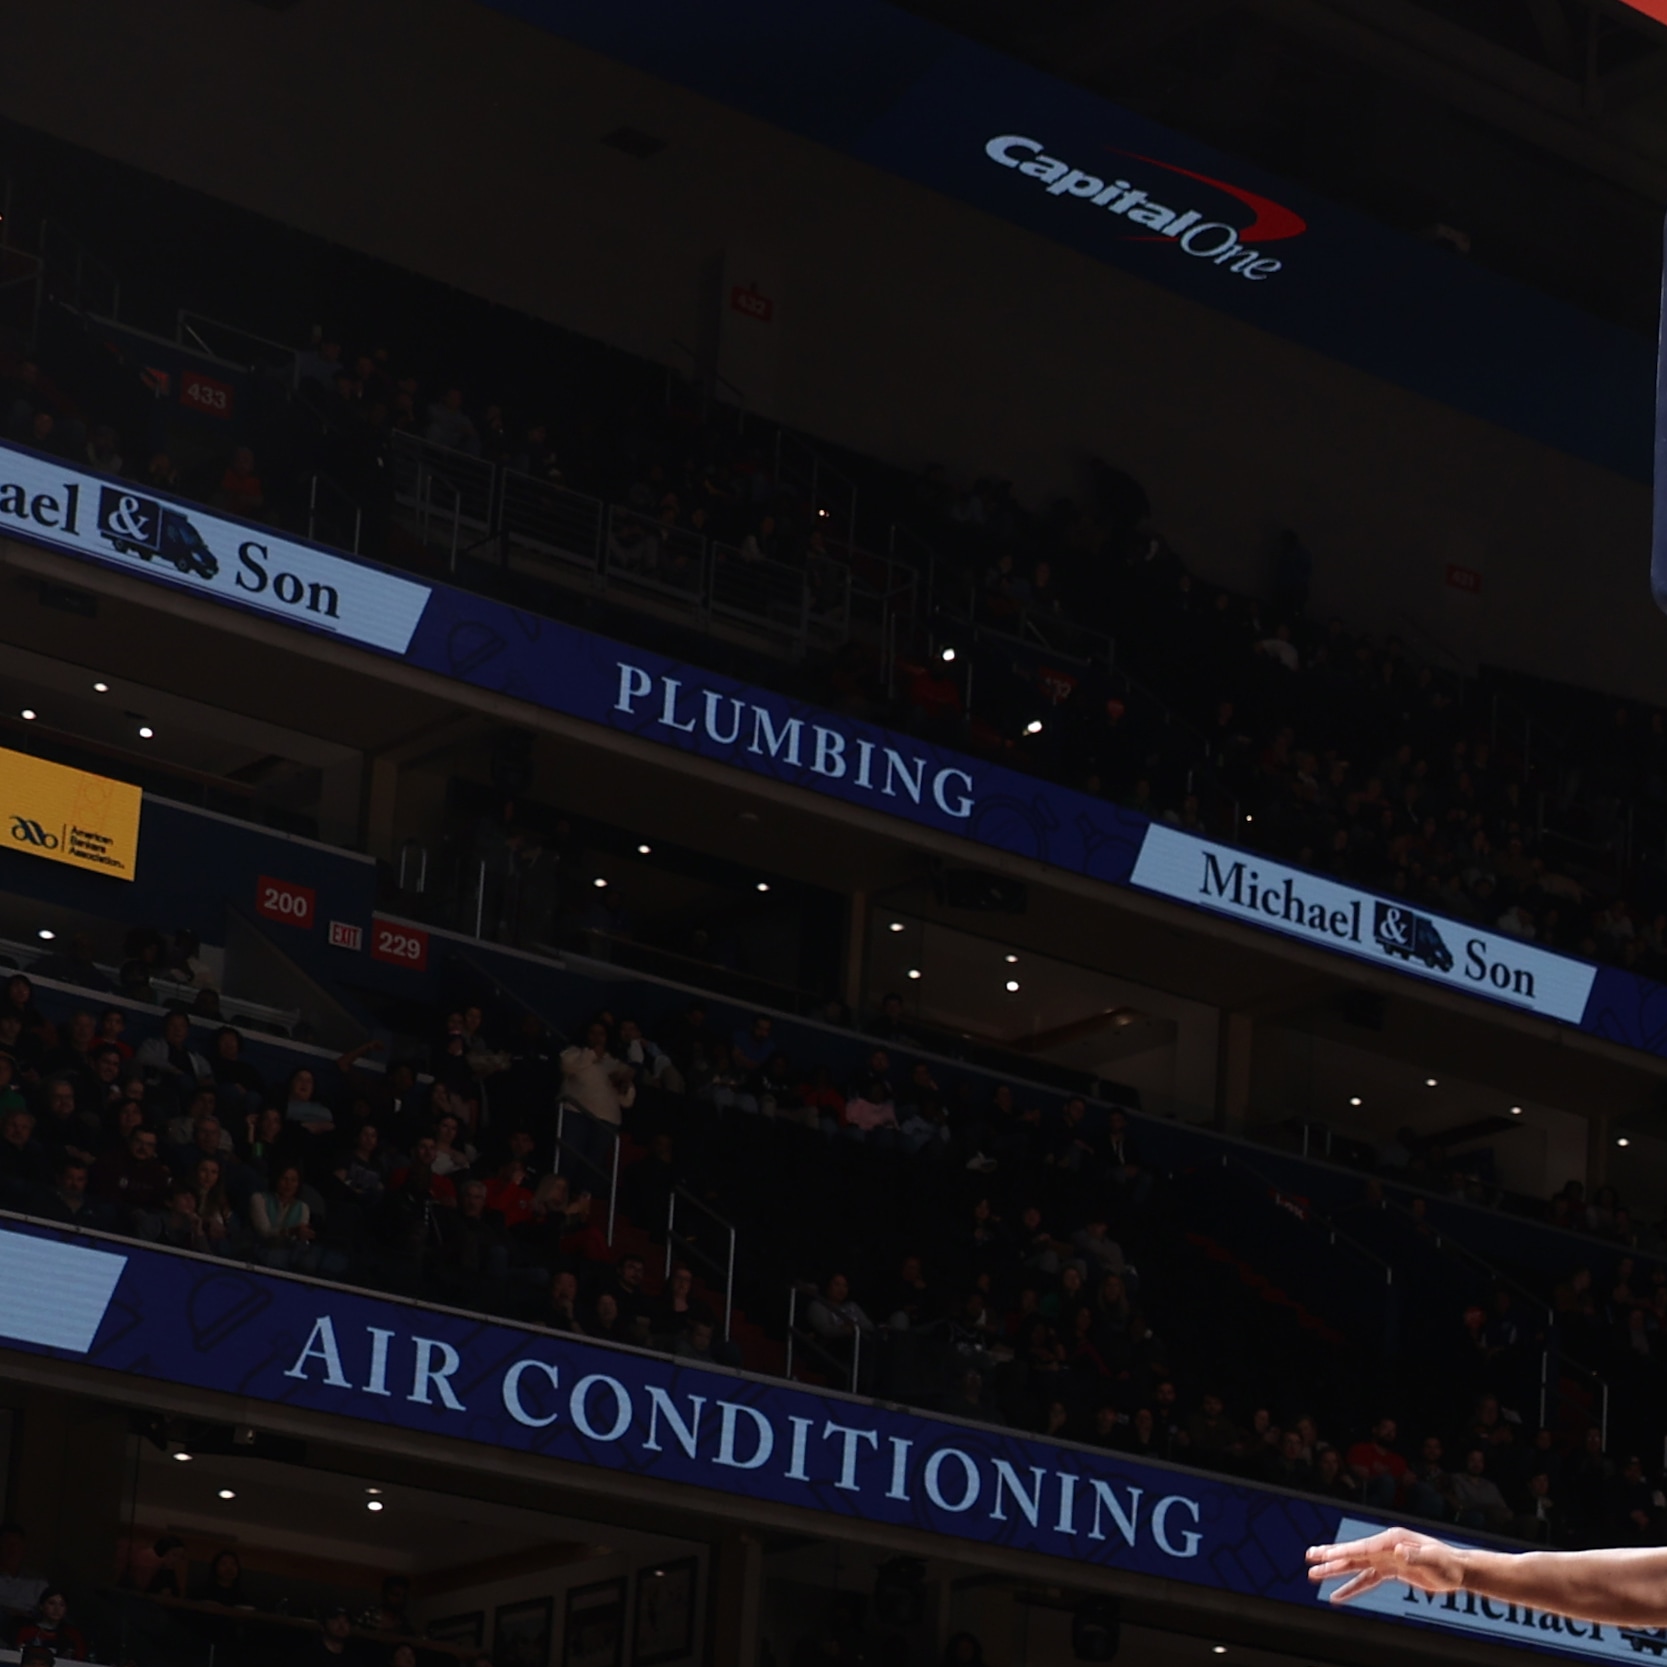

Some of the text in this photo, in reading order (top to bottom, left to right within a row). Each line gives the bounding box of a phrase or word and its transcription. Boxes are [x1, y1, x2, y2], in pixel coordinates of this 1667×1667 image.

[188, 382, 226, 410] 433
[235, 541, 341, 619] Son
[614, 661, 975, 820] PLUMBING
[263, 887, 308, 918] 200
[1201, 853, 1361, 942] Michael
[1465, 938, 1537, 999] Son
[331, 924, 359, 946] EXIT
[378, 931, 422, 961] 229
[283, 1315, 1202, 1559] AIR CONDITIONING
